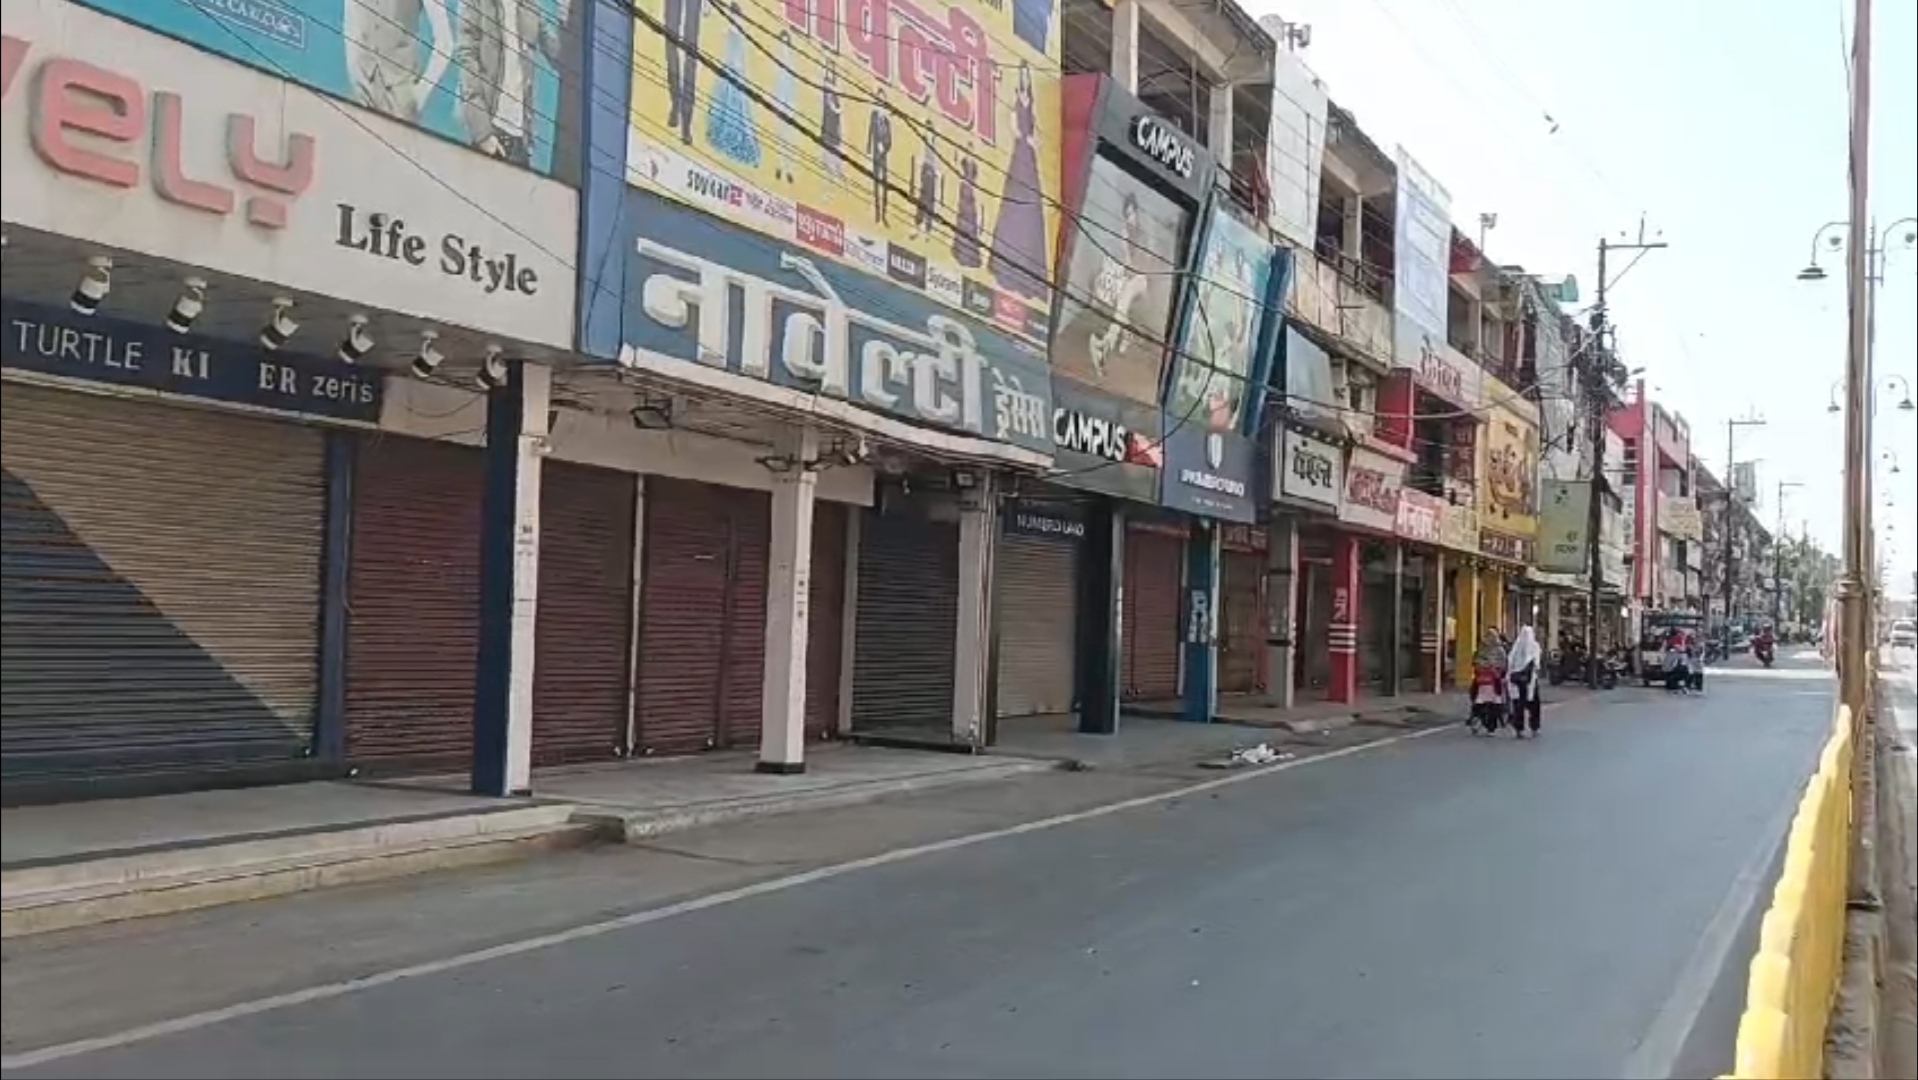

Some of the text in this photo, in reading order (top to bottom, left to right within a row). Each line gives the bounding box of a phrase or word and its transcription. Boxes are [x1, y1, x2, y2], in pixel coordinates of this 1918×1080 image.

[1137, 115, 1195, 178] CAMPUS
[335, 203, 538, 295] Life Style
[12, 320, 143, 370] TURTLE
[312, 374, 373, 403] zeris
[1053, 408, 1126, 461] CAMPUS
